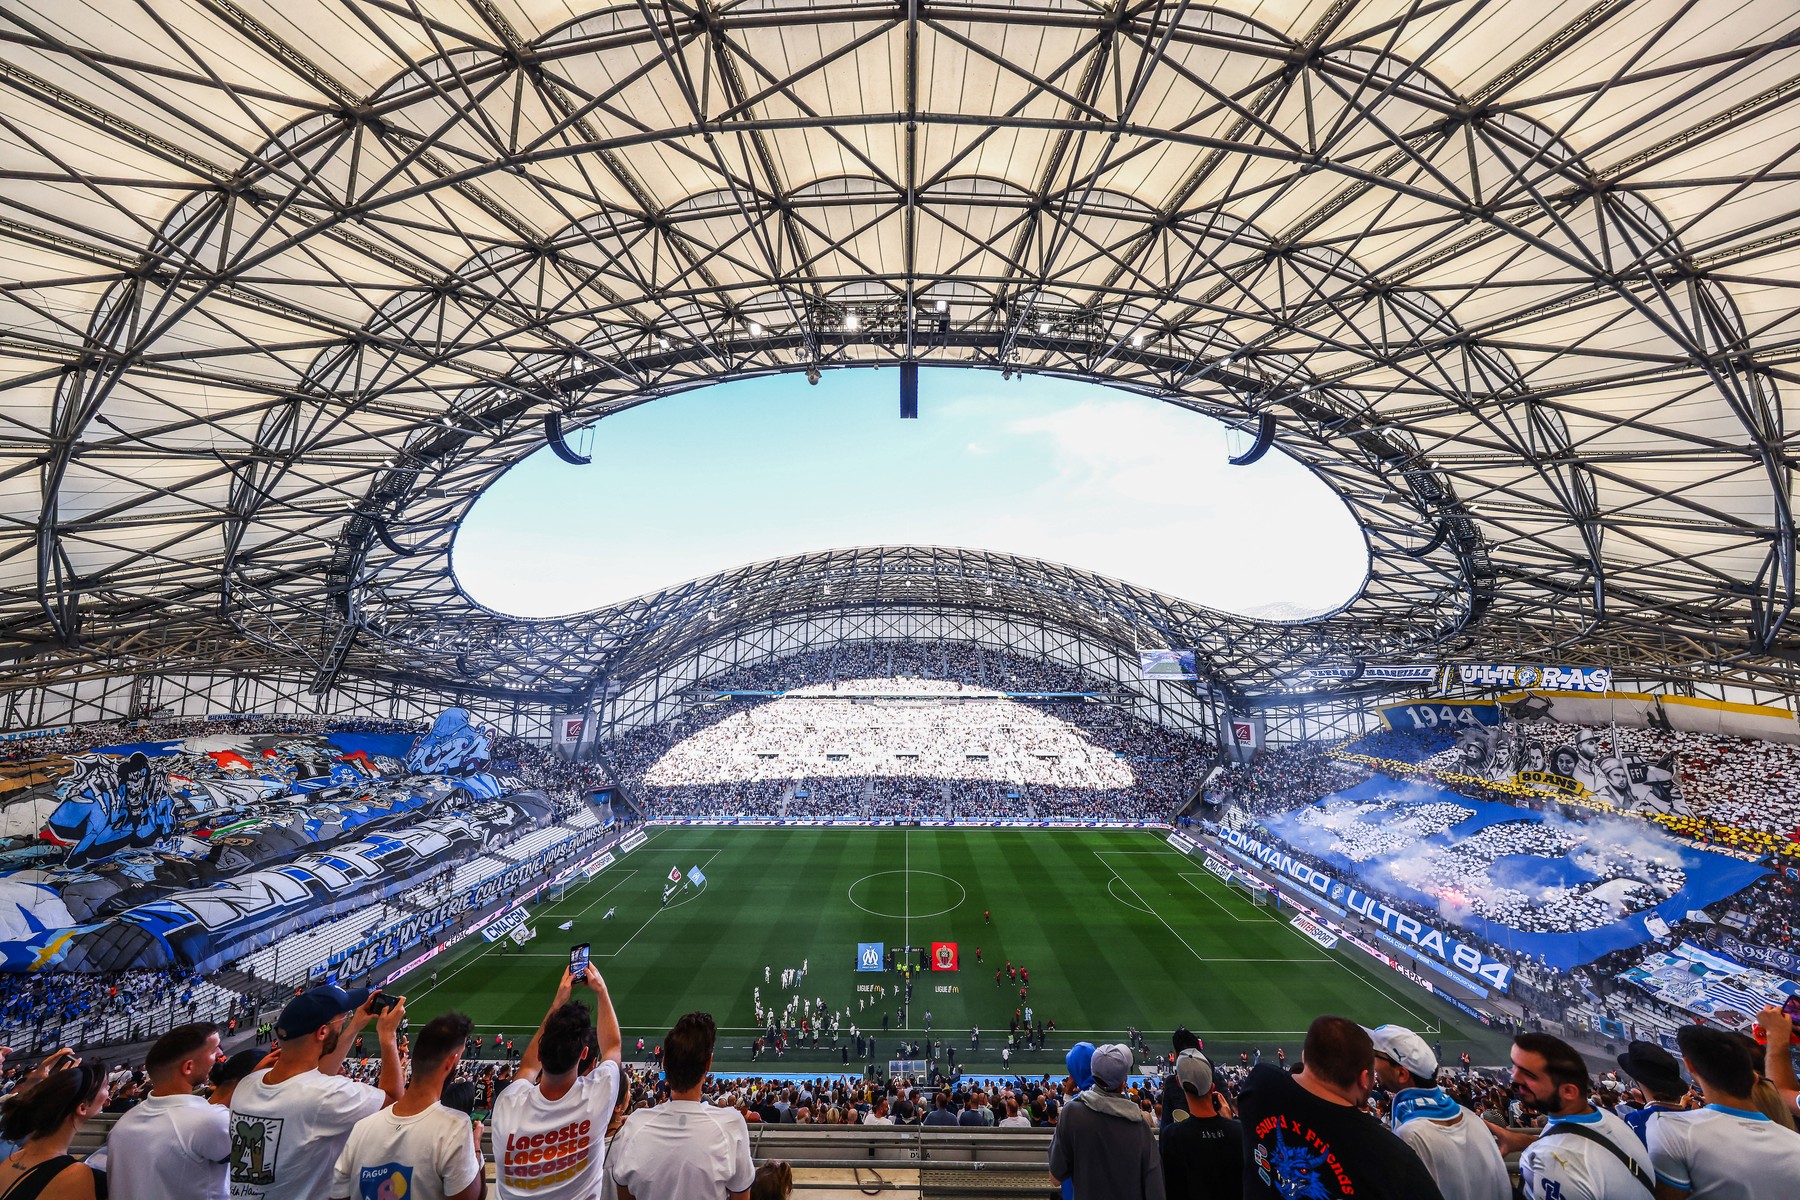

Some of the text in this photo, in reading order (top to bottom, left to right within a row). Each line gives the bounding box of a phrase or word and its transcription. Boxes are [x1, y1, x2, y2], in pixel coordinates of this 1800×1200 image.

[1406, 706, 1473, 729] 1944
[1522, 772, 1578, 791] 80 ANS
[1630, 768, 1644, 780] FFI
[1218, 826, 1331, 893] COMMANDO
[1299, 916, 1334, 945] INTERSPORT
[338, 940, 380, 979] QUE
[1738, 944, 1789, 963] 1984 40
[935, 985, 948, 993] LIGUE
[507, 1119, 591, 1152] Lacoste
[504, 1148, 589, 1177] Lacoste
[505, 1136, 590, 1166] Lacoste
[362, 1168, 388, 1179] FAGUO
